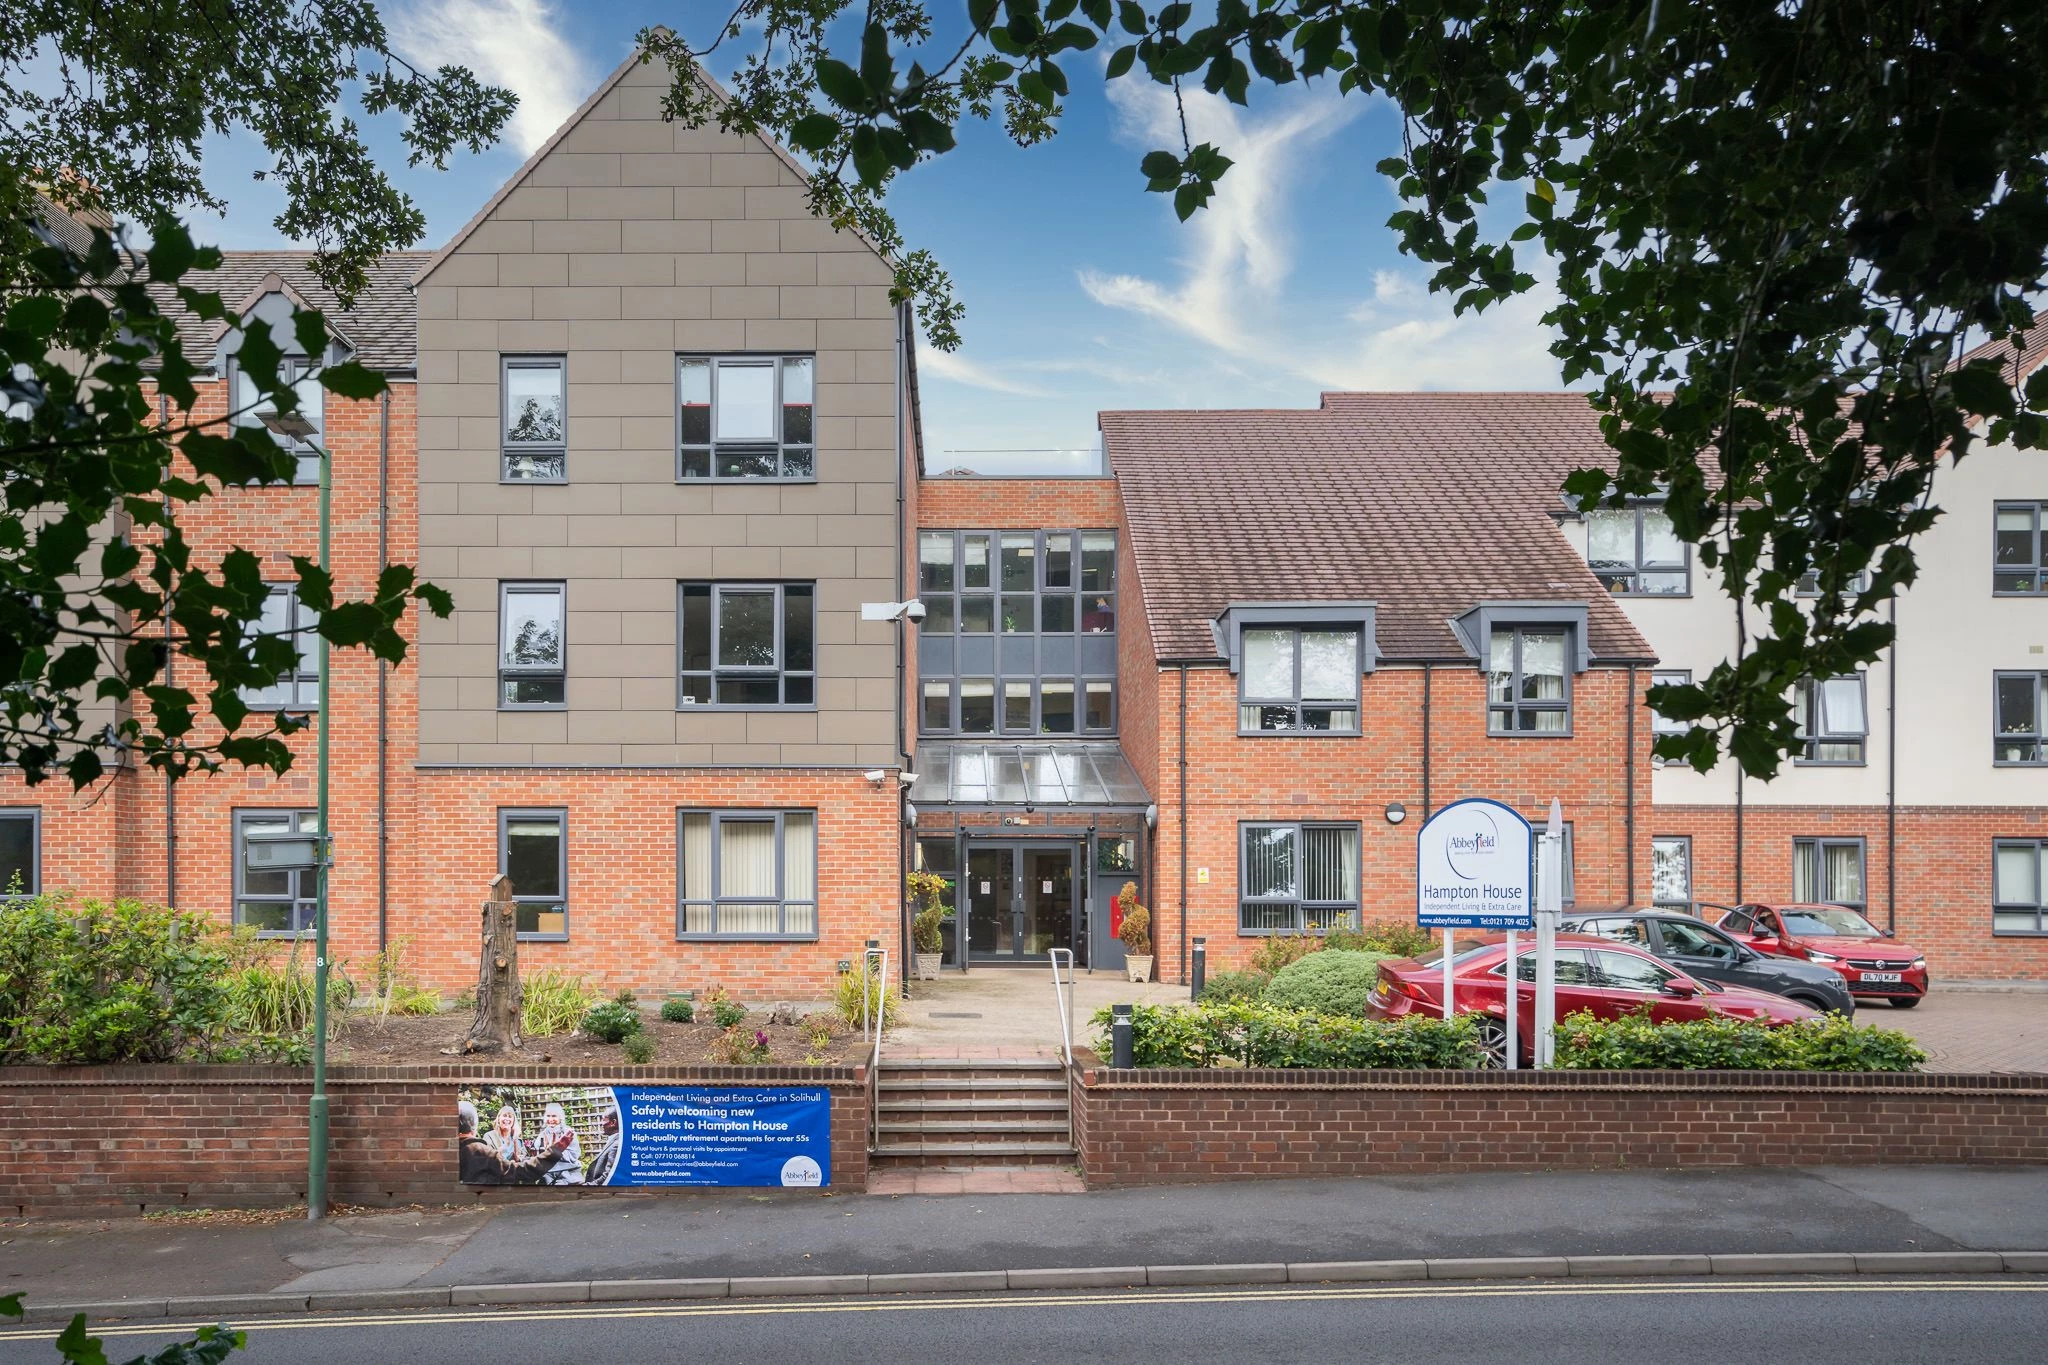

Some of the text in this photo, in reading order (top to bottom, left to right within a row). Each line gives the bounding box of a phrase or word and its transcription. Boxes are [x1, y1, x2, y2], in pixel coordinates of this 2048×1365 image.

[1450, 833, 1495, 853] Abbeyfield
[1424, 884, 1522, 901] Hampton House
[1424, 902, 1460, 911] Independent
[1462, 903, 1480, 911] Living
[1420, 917, 1472, 925] www.abbeyfield.com
[317, 957, 324, 967] 8
[631, 1092, 821, 1104] Independent Living and Extra Care in Solihull
[631, 1105, 755, 1119] Safely welcoming new
[631, 1119, 788, 1132] residents to Hampton House
[631, 1134, 678, 1143] High-quality
[720, 1135, 762, 1143] apartments
